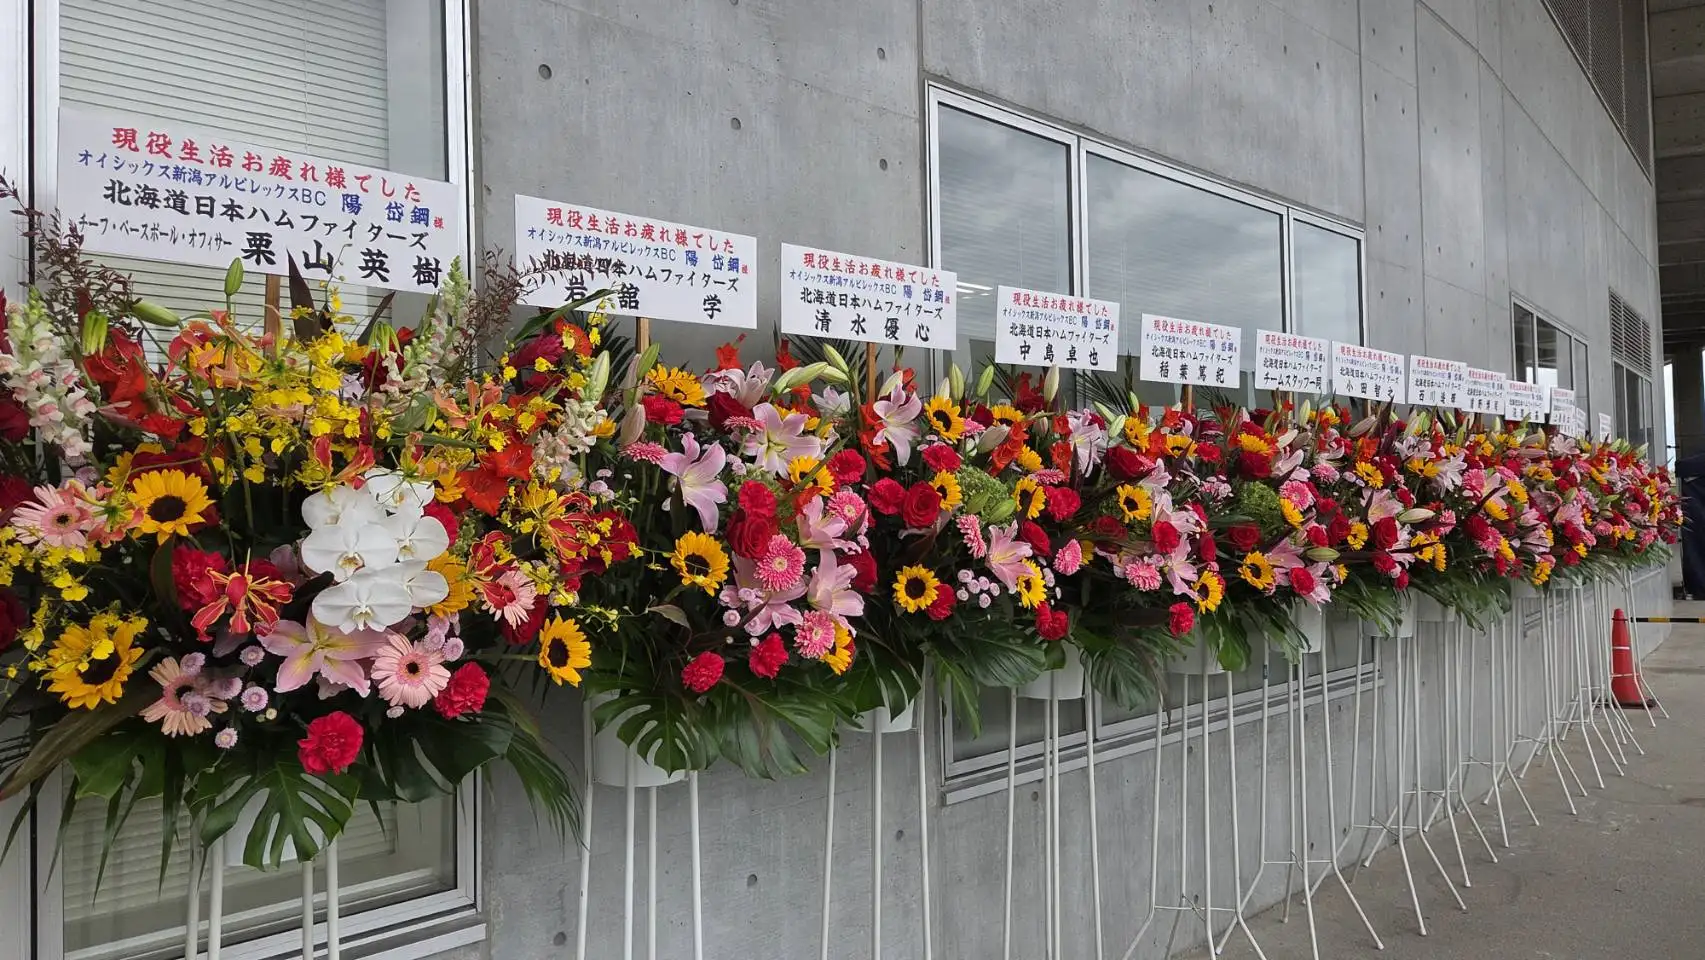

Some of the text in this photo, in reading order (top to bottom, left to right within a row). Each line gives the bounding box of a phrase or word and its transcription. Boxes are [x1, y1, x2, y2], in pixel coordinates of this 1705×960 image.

[78, 150, 326, 207] オイシックス新潟アルビレックスBC
[112, 128, 422, 202] 現役生活お疲れ様でした
[104, 179, 430, 250] 北海道日本ハムファイターズ
[547, 207, 734, 254] 現役生活お疲れ様でした
[528, 227, 676, 261] オイシックス新潟アルビレックスBC
[790, 269, 896, 294] オイシックス新潟アルビレックスBC
[804, 253, 940, 287] 現役生活お疲れ様でした
[800, 287, 943, 320] 北海道日本ハムファイターズ
[1013, 293, 1108, 316] 現役生活お疲れ様でした
[1010, 322, 1109, 344] 北海道日本ハムファイターズ
[1152, 346, 1233, 365] 北海道日本ハムファイターズ
